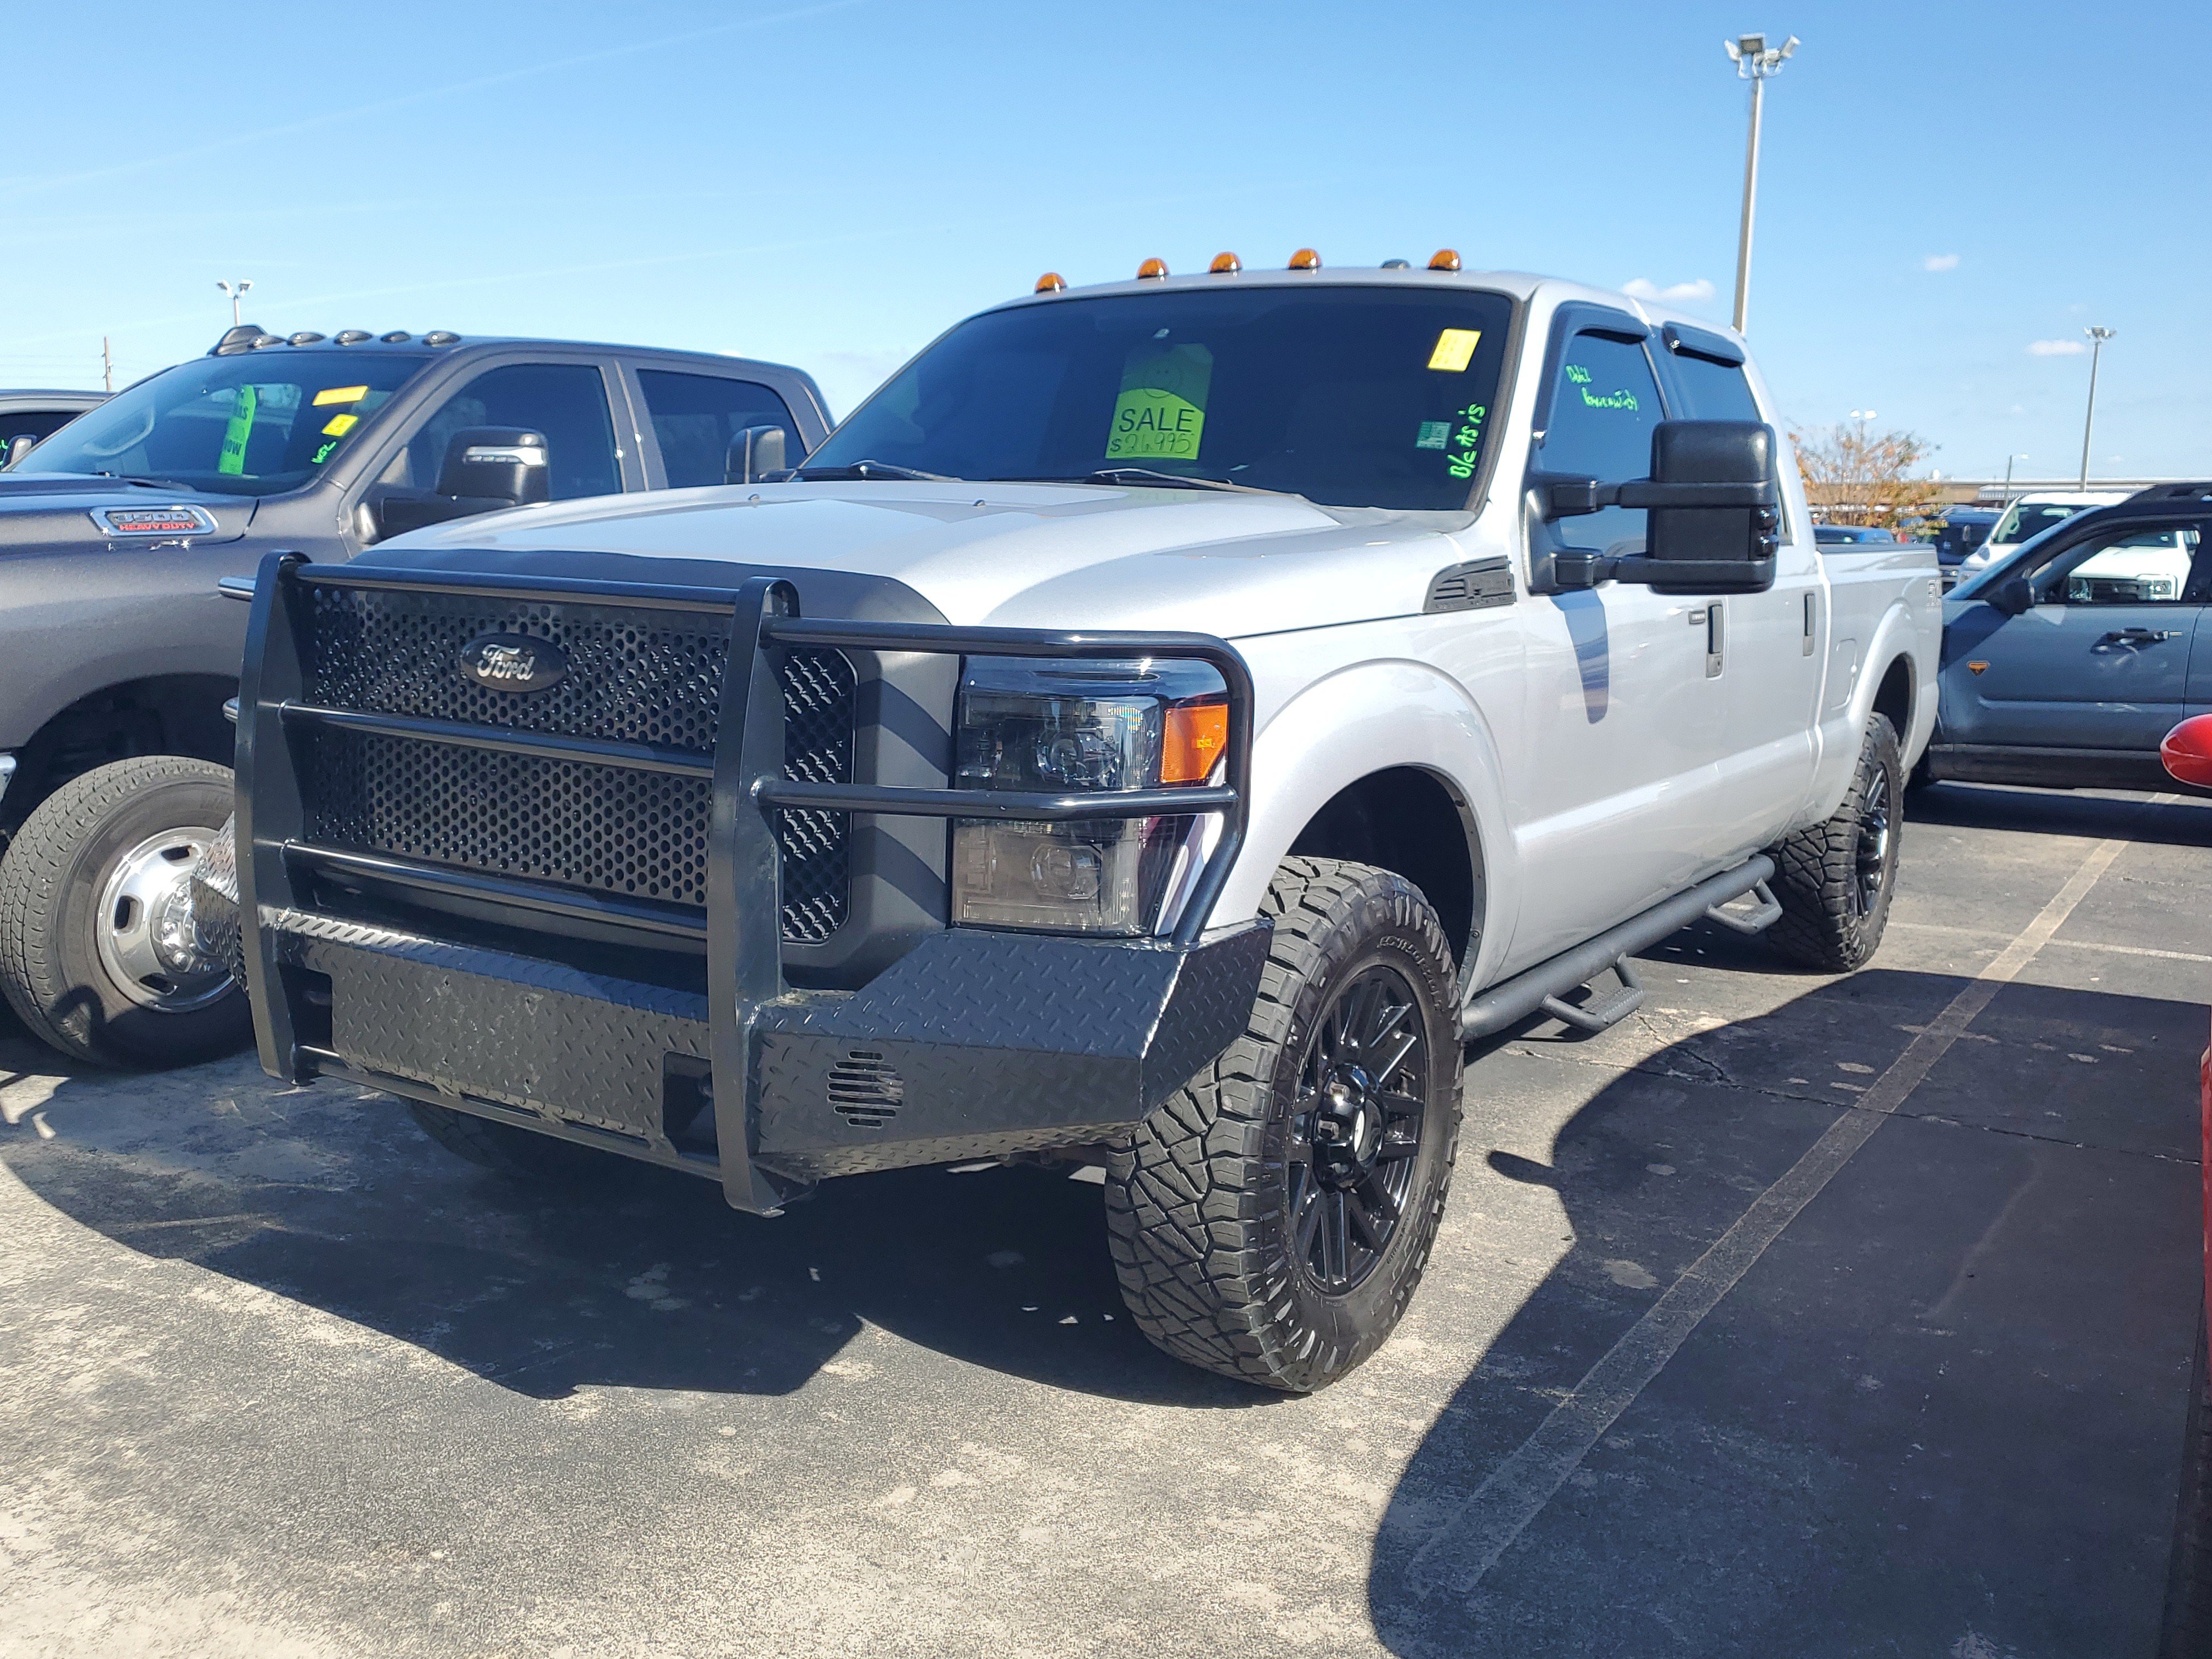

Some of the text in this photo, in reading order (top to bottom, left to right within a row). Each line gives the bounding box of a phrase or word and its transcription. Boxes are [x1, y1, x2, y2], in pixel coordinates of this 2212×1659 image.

[1119, 408, 1195, 432] SALE
[161, 522, 195, 531] DUTY
[477, 644, 535, 680] Ford
